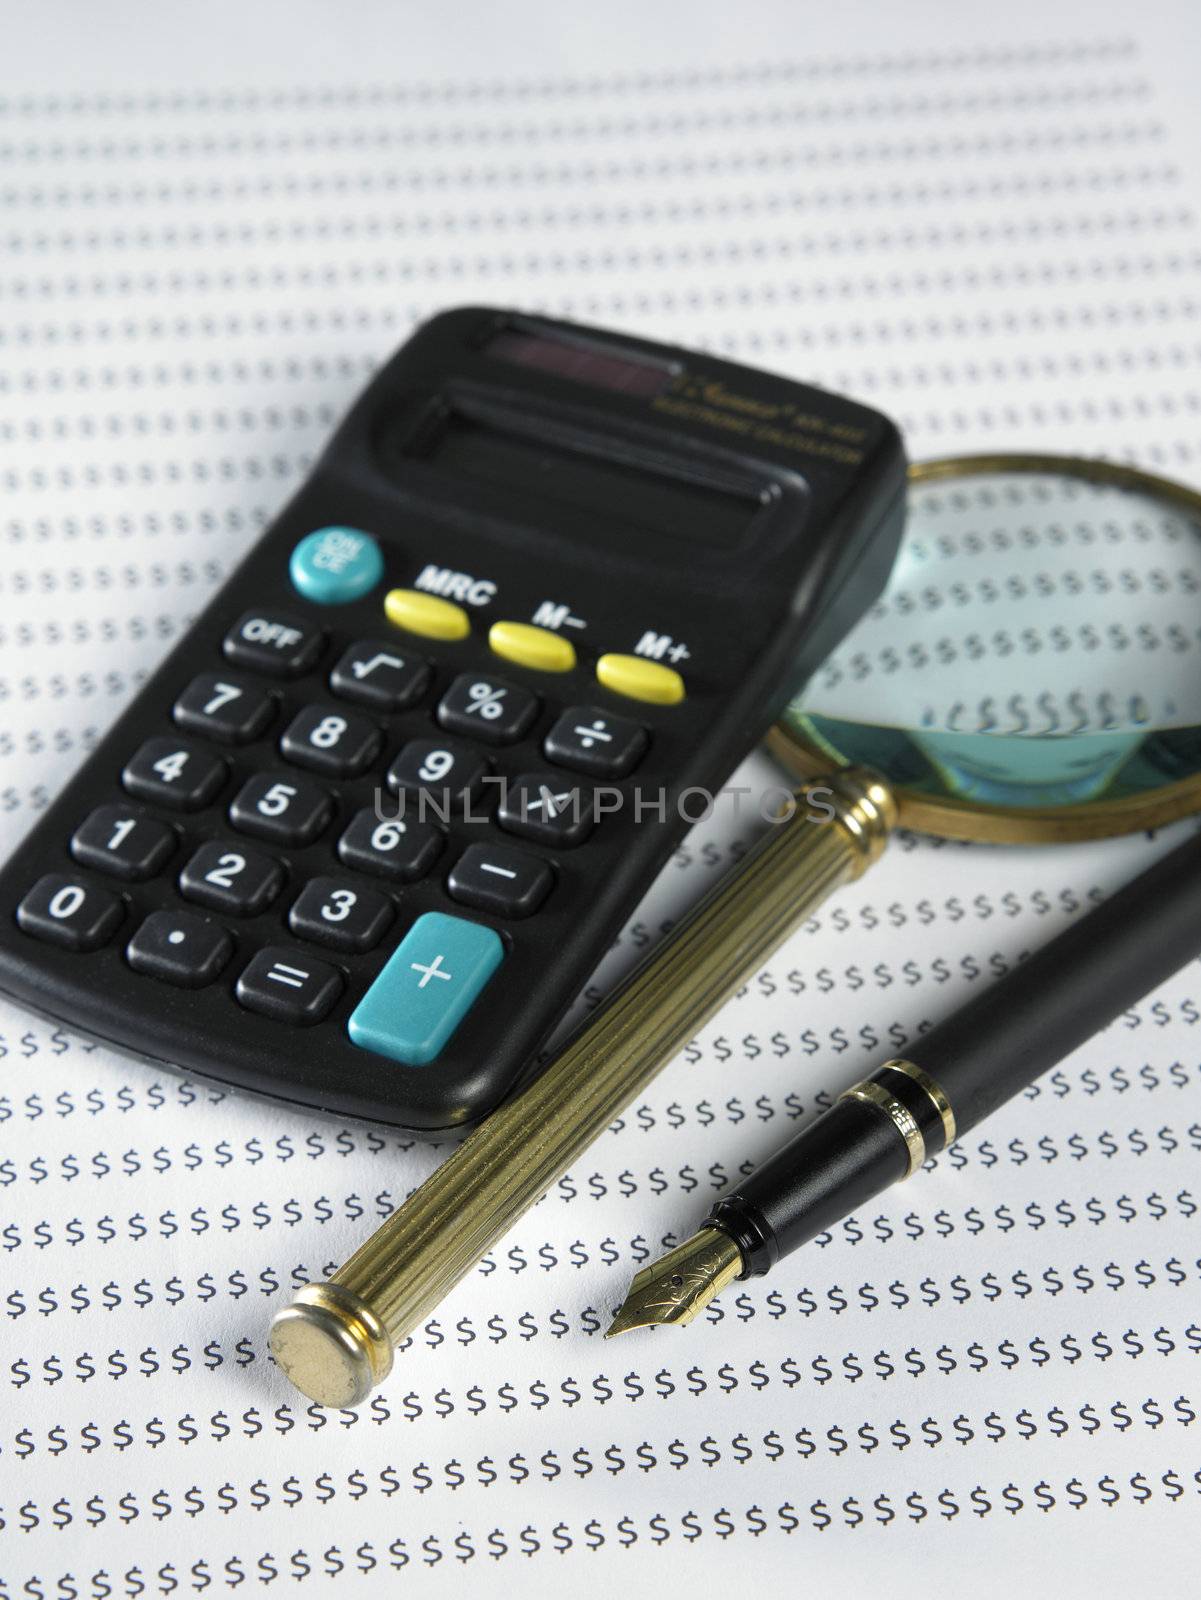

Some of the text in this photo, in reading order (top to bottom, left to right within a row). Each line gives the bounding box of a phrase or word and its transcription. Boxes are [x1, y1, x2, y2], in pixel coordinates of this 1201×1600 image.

[414, 564, 498, 606] MRC
[242, 619, 302, 648] OFF
[635, 632, 690, 664] M+
[204, 683, 241, 714] 7
[466, 683, 505, 720] %
[310, 716, 347, 748] 8
[153, 751, 188, 782] 4
[419, 750, 454, 782] 9
[258, 784, 296, 816] 5
[108, 819, 135, 850] 1
[371, 819, 406, 851] 6
[205, 853, 246, 888] 2
[49, 885, 85, 918] 0
[321, 889, 357, 922] 3
[410, 954, 452, 988] +
